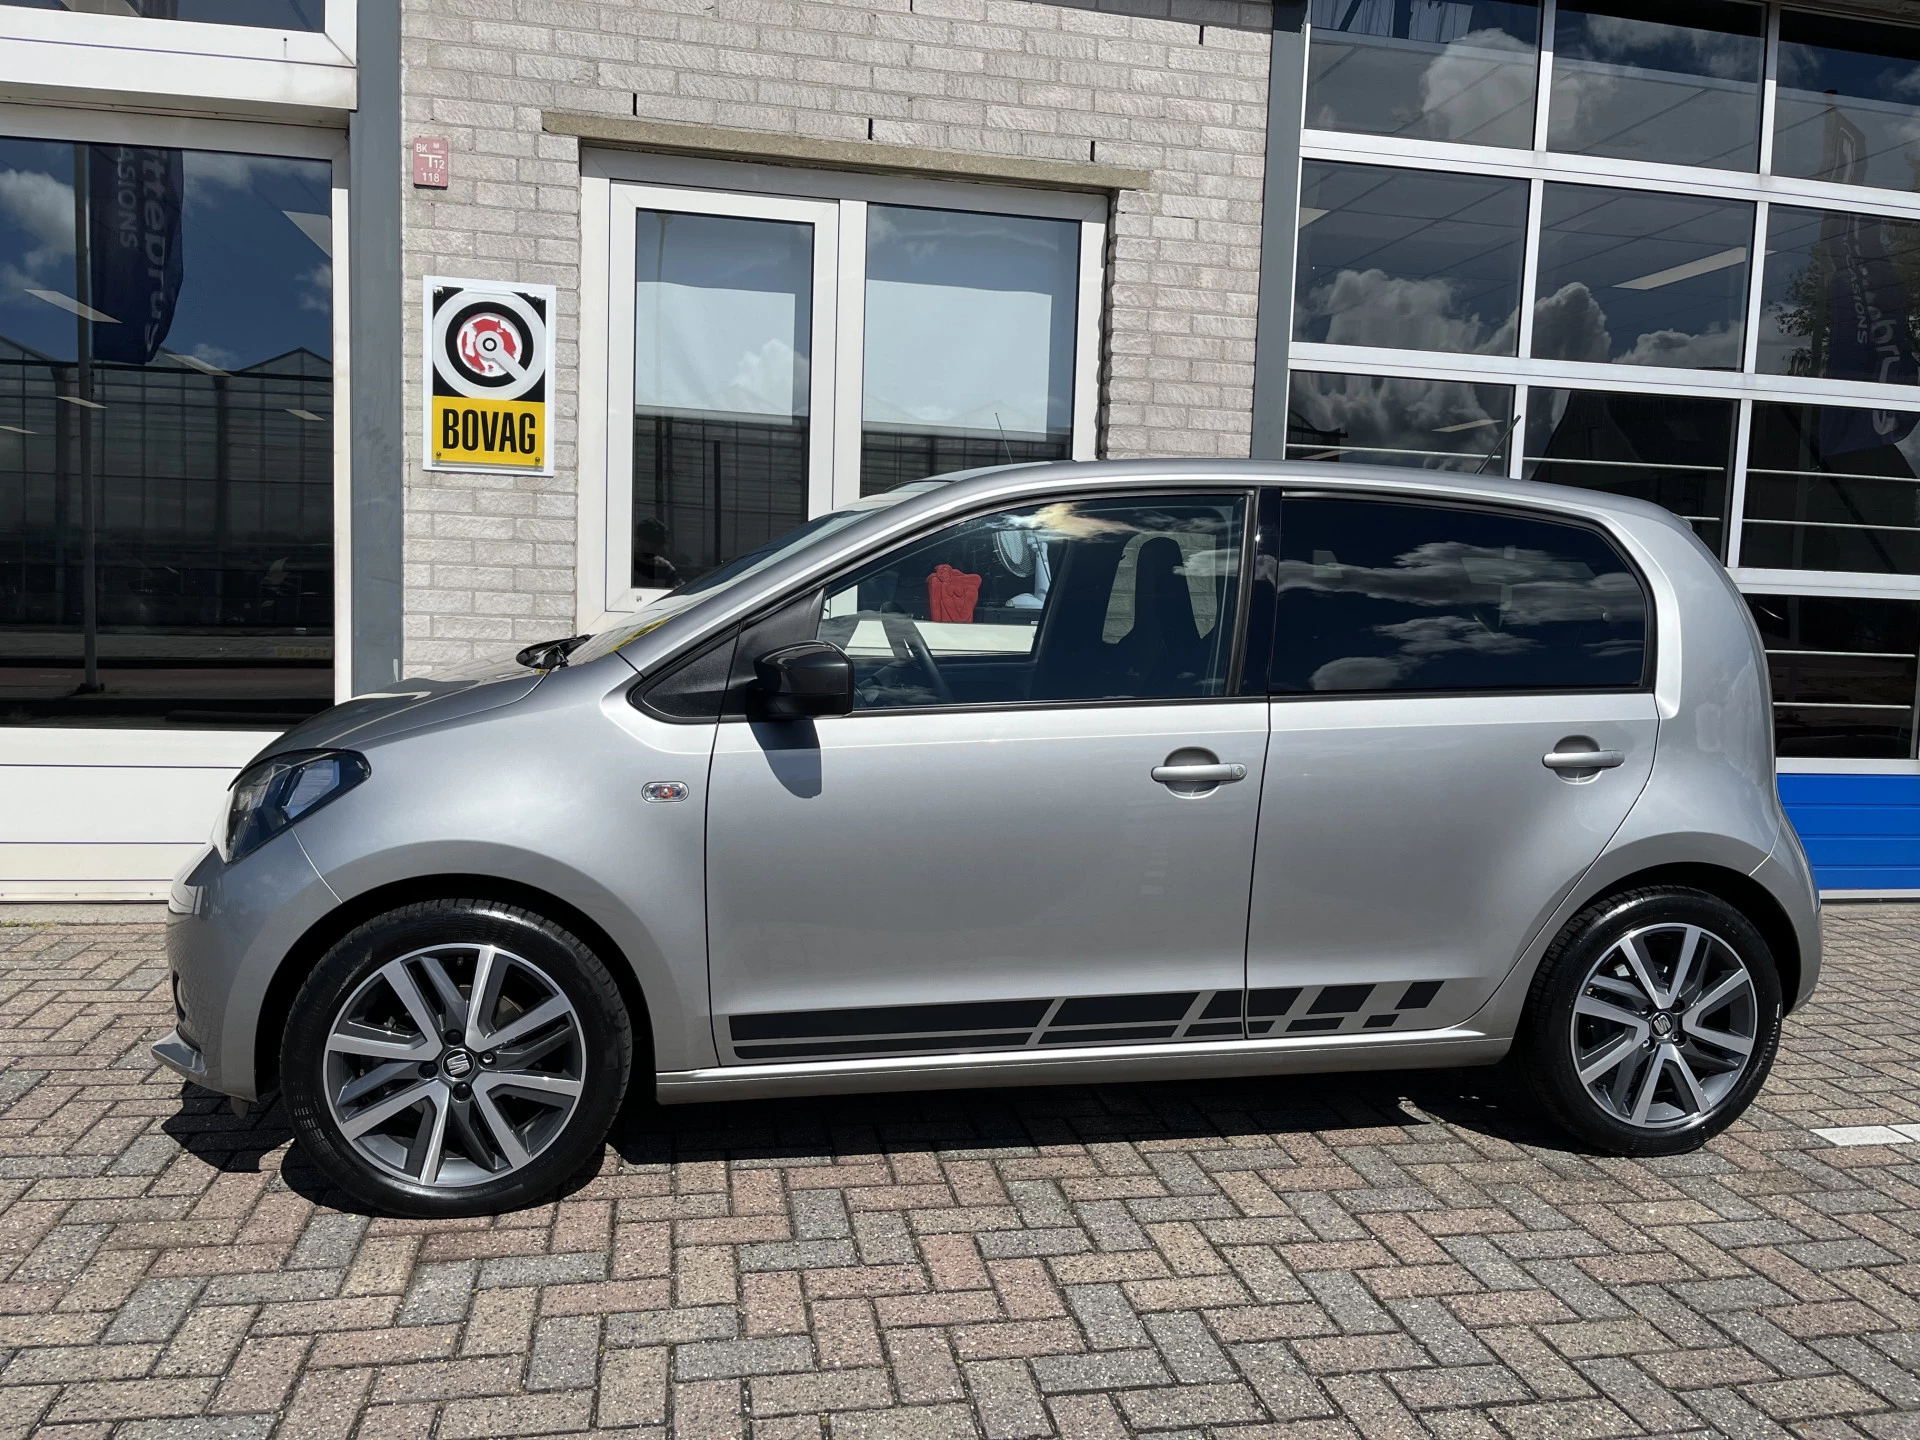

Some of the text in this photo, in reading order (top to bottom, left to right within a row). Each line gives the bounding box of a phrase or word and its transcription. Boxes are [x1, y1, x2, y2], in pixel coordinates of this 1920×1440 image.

[416, 143, 428, 153] BK
[433, 159, 445, 170] 12
[422, 172, 440, 183] 118
[442, 408, 536, 454] BOVAG
